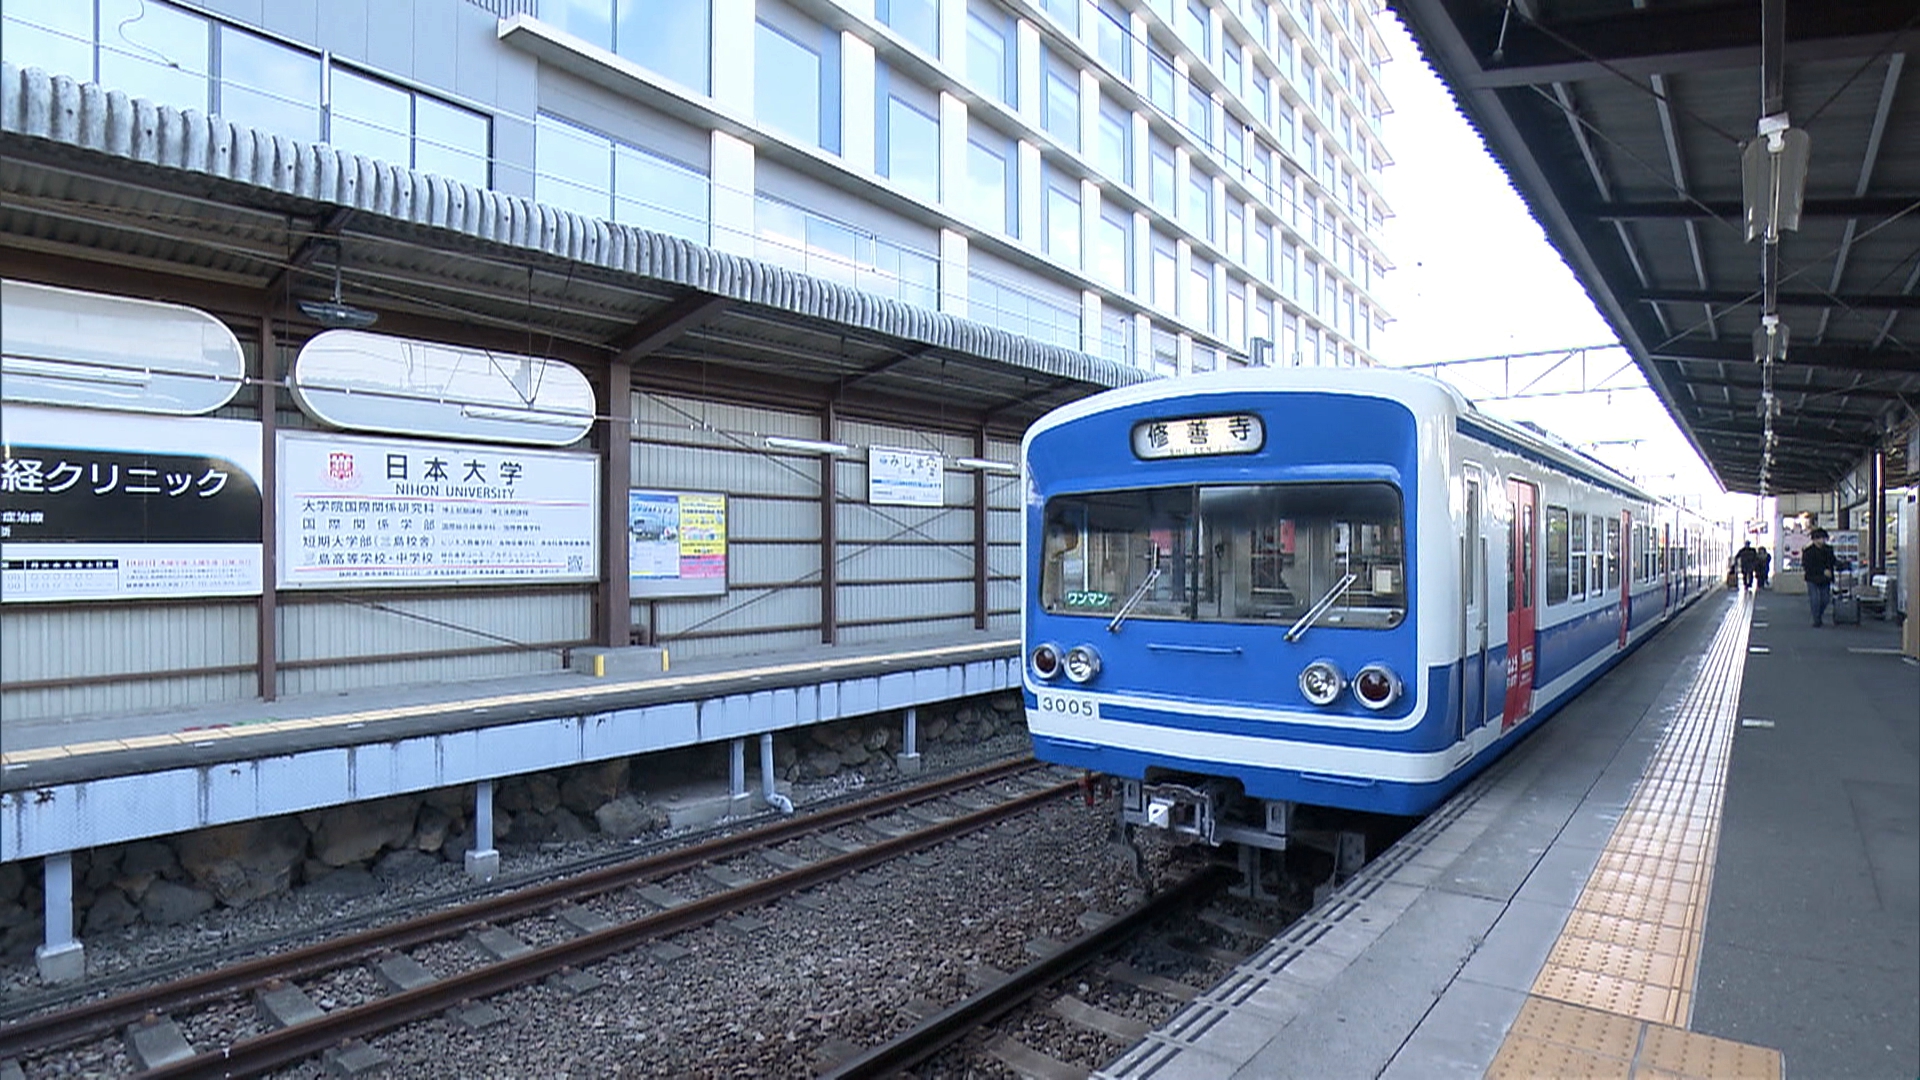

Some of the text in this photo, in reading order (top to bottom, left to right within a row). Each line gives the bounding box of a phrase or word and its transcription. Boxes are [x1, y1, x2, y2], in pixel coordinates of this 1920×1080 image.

[1147, 415, 1251, 448] 修善寺
[1, 458, 229, 498] 経クリニック
[386, 453, 522, 486] 日本大学
[395, 483, 515, 500] NIHON UNIVERSITY
[1068, 592, 1108, 606] ワンマン
[1042, 696, 1093, 717] 3005
